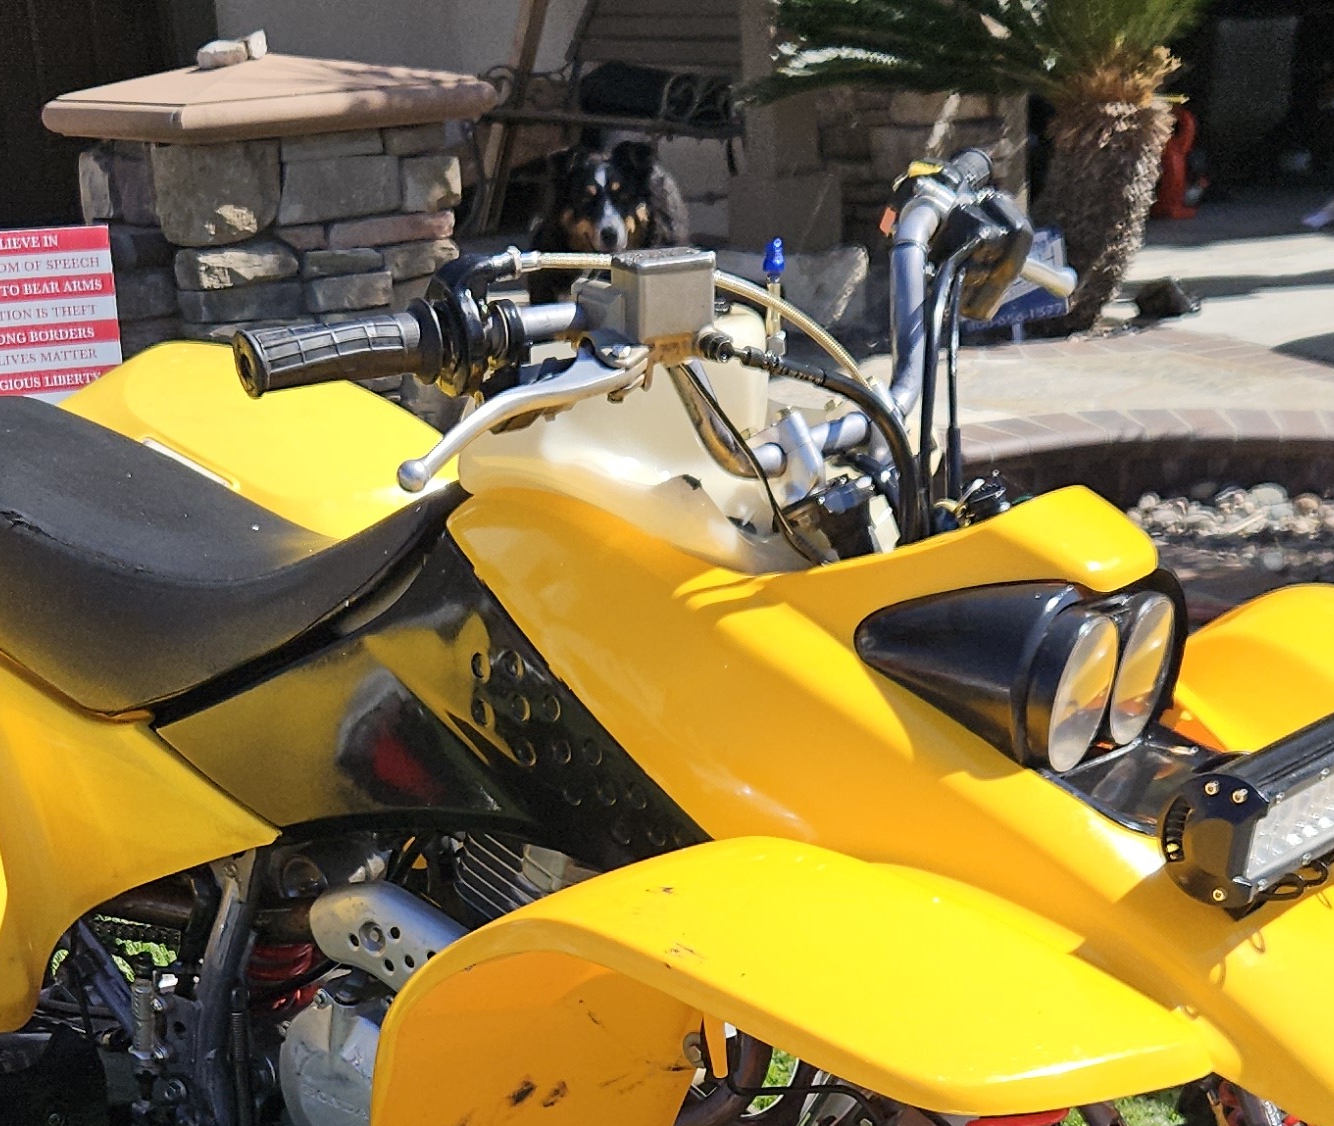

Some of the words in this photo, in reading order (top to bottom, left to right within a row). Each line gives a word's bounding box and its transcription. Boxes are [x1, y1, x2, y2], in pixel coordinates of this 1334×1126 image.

[43, 235, 58, 247] IN
[24, 259, 41, 271] OF
[46, 257, 100, 270] SPEECH
[0, 284, 19, 297] TO
[23, 281, 60, 295] BEAR
[63, 279, 102, 291] ARMS
[36, 307, 48, 319] IS
[51, 304, 97, 316] THEFT
[30, 326, 95, 343] BORDERS
[40, 348, 97, 362] MATTER
